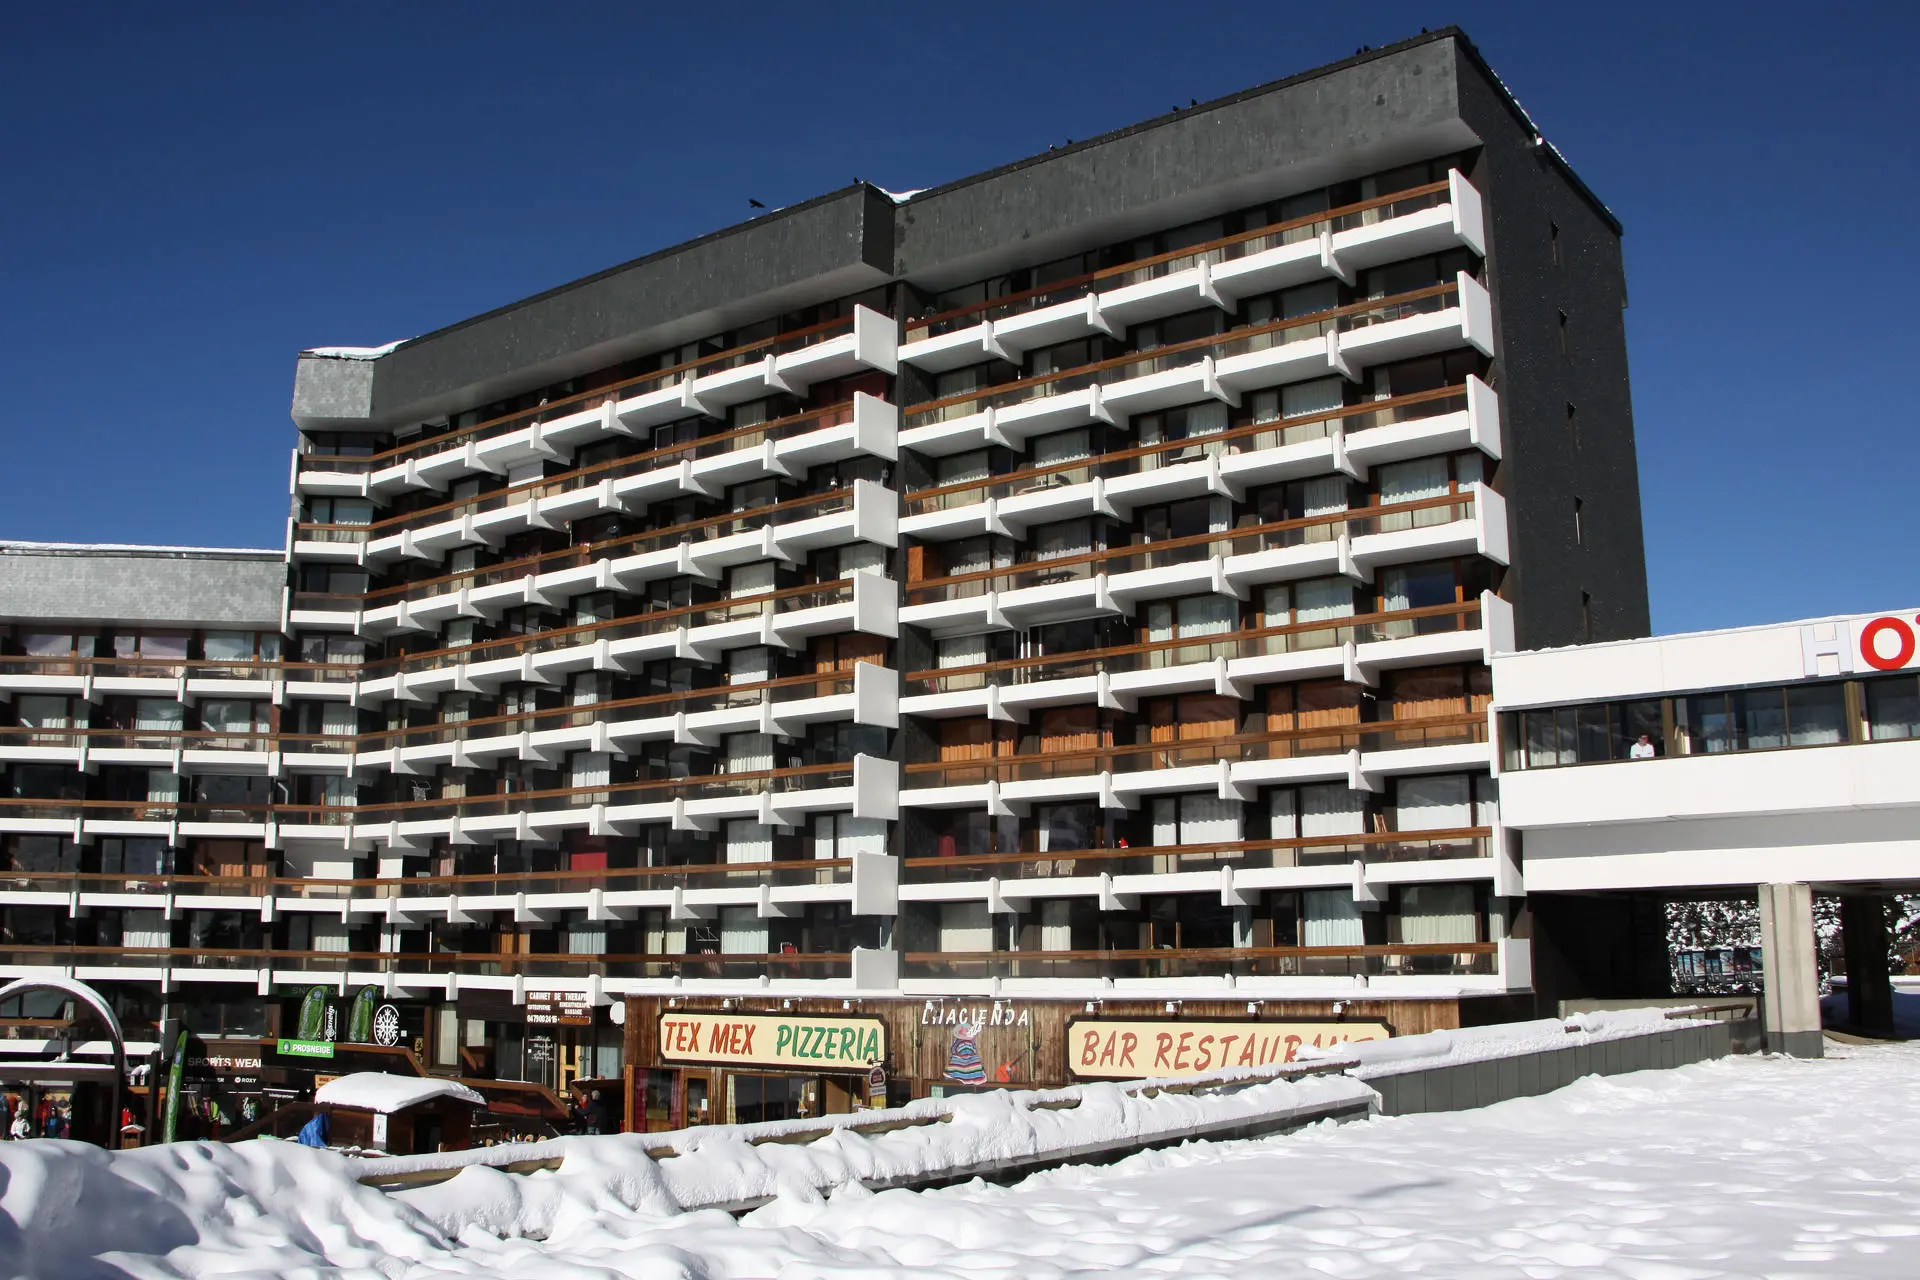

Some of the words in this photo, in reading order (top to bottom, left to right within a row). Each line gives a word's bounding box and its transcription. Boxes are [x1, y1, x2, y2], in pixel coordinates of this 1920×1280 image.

[1800, 616, 1920, 678] HO
[665, 1022, 702, 1052] TEX
[709, 1023, 756, 1055] MEX
[776, 1024, 879, 1061] PIZZERIA
[1081, 1030, 1138, 1069] BAR
[1154, 1031, 1375, 1071] RESTAUR
[188, 1057, 231, 1067] SPORTS
